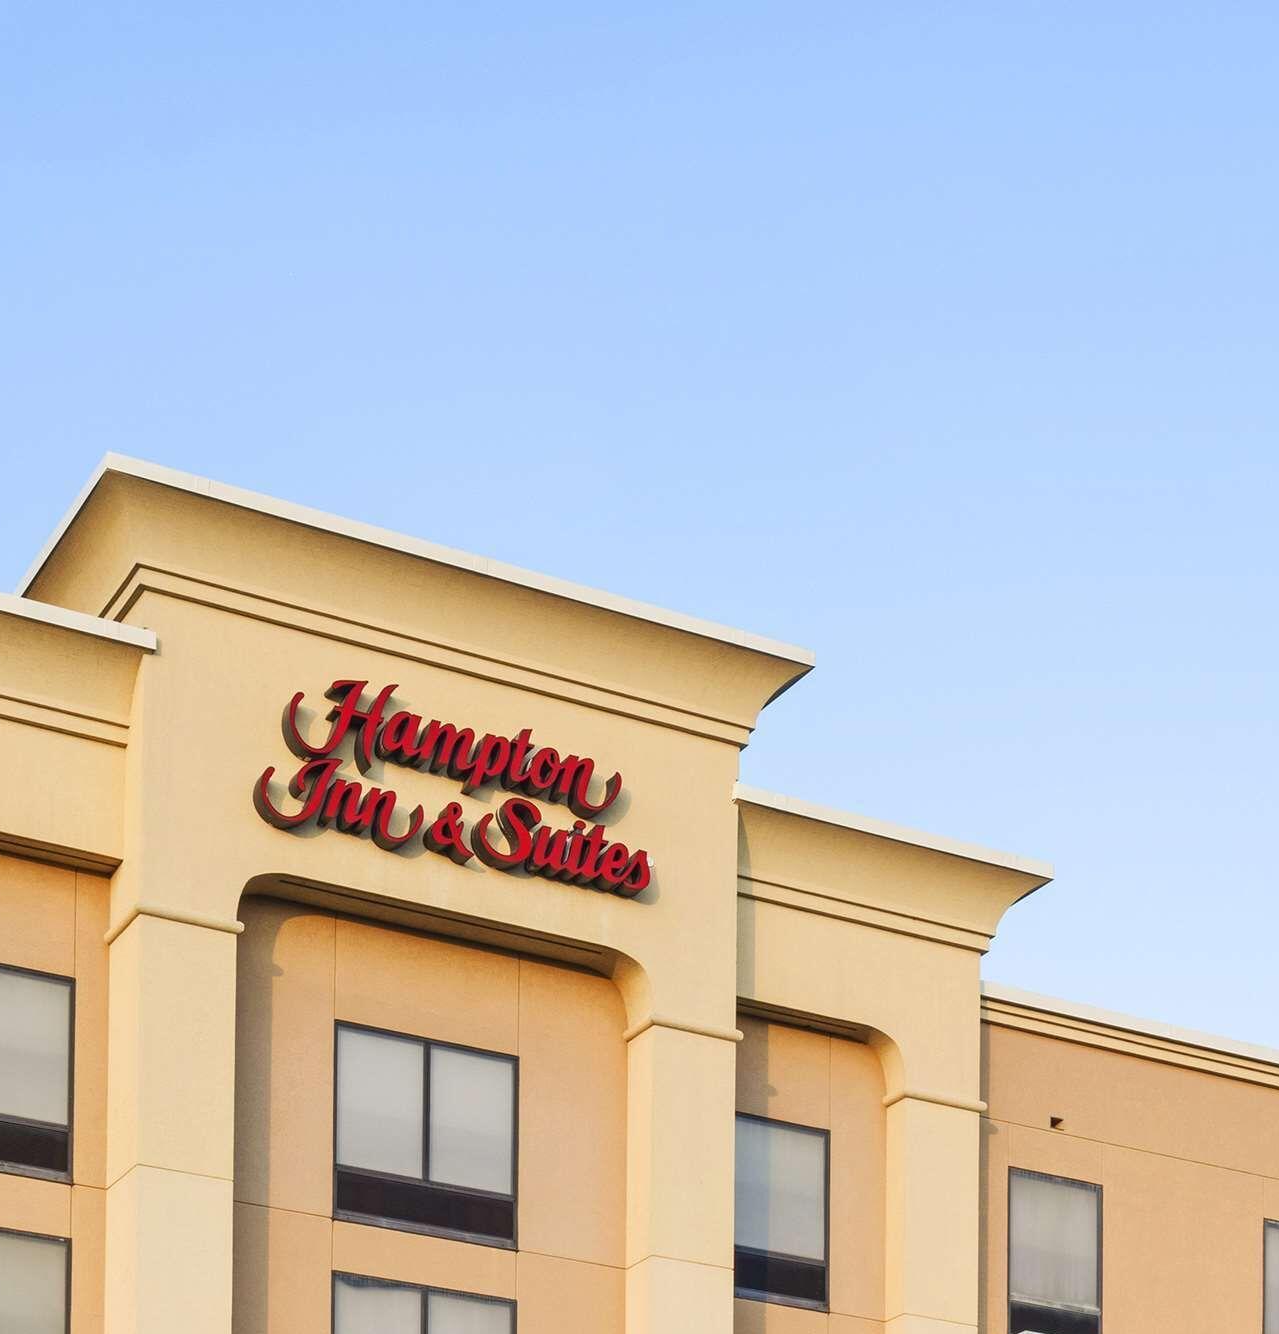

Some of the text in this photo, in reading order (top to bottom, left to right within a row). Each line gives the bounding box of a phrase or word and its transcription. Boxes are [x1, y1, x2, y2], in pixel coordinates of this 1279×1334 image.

[282, 680, 622, 818] Hampton
[253, 758, 651, 898] Inn & Suites
